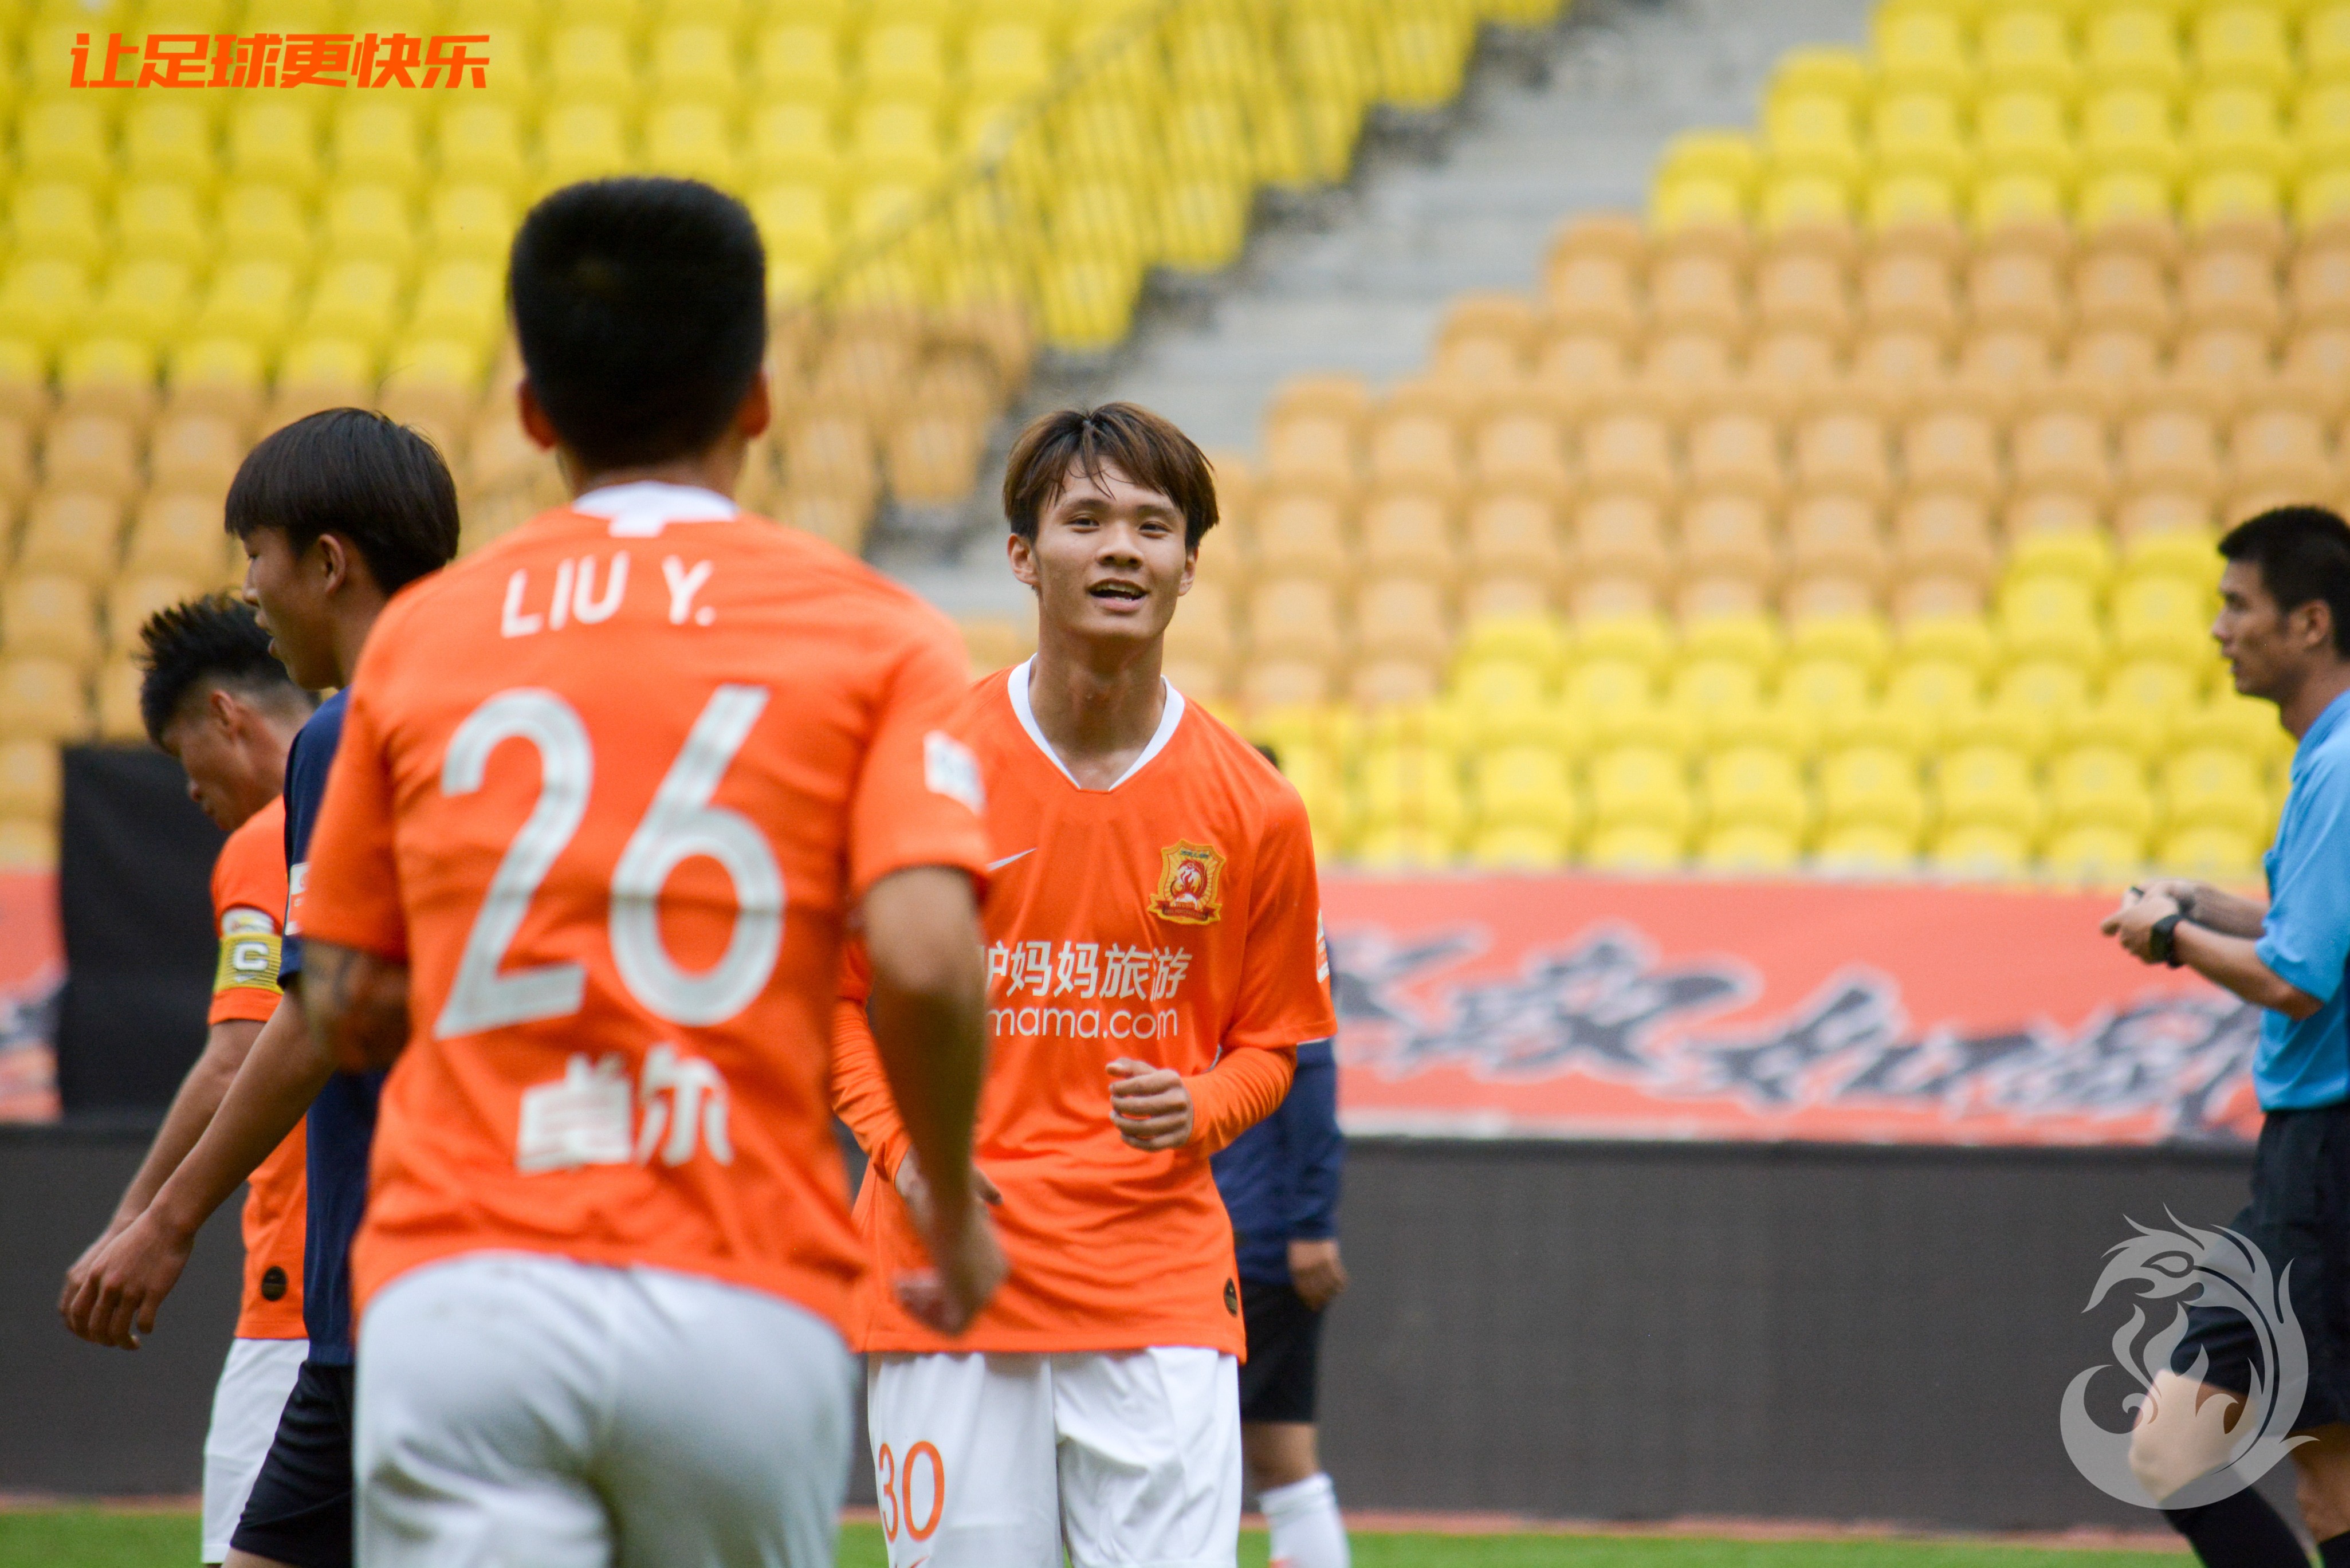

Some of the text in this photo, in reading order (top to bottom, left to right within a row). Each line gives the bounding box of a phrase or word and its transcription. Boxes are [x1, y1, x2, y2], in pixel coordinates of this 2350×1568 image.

[500, 549, 717, 638] LIU Y.
[432, 683, 787, 1040] 26
[233, 941, 269, 970] C
[878, 1440, 945, 1544] 30
